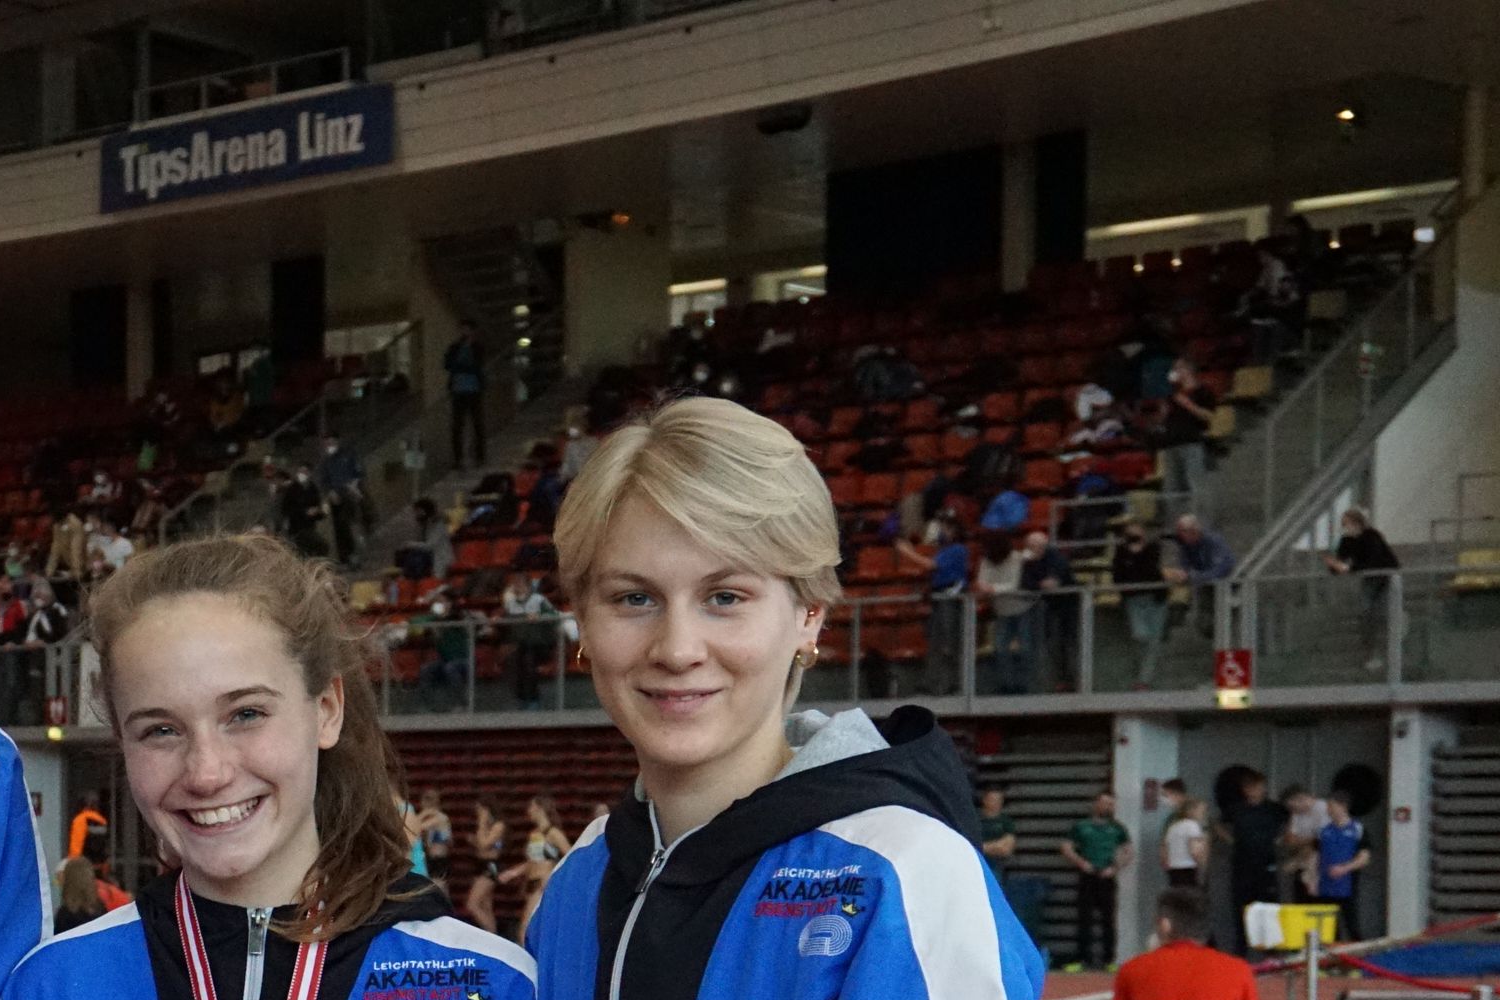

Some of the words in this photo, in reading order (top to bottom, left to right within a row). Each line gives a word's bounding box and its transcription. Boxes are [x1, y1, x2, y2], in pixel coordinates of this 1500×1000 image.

[118, 130, 288, 200] TipsArena
[297, 111, 366, 161] Linz
[758, 876, 867, 901] AKADEMIE
[373, 957, 476, 971] LEICHTATHLETIK
[364, 968, 491, 991] AKADEMIE
